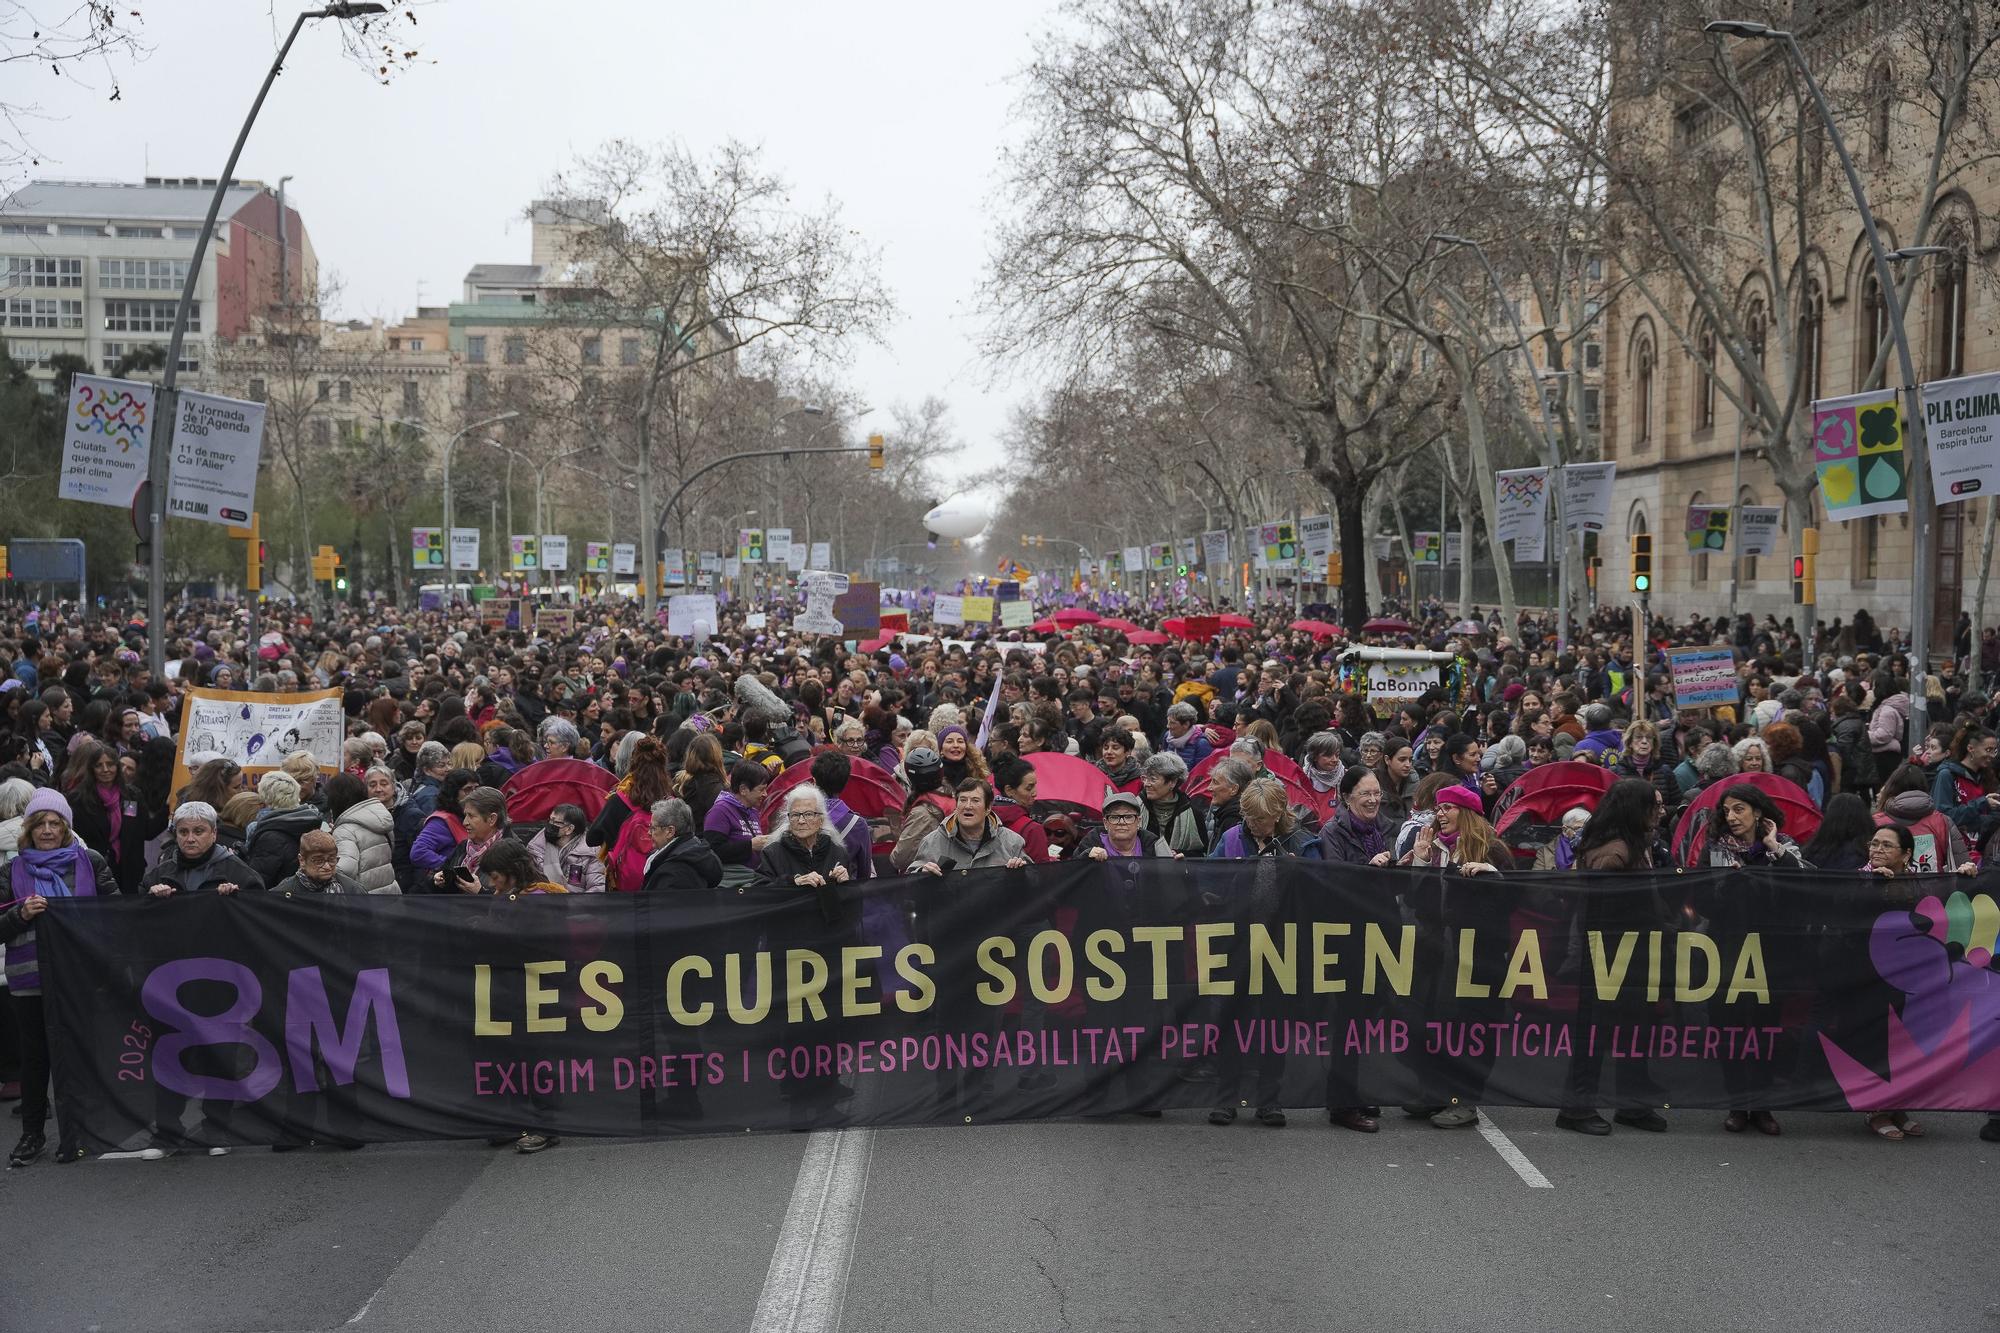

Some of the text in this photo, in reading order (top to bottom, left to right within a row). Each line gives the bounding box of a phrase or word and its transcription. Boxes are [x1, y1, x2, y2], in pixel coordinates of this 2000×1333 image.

[184, 401, 245, 422] IV Jornada
[1926, 392, 2000, 425] PLA CLIMA
[181, 423, 209, 437] 2030
[183, 412, 250, 433] de l'Agenda
[1940, 425, 1987, 439] Barcelona
[73, 440, 107, 453] Ciutats
[1936, 434, 1994, 451] respira futur
[71, 454, 90, 463] que
[105, 459, 136, 470] mouen
[177, 454, 192, 465] Ca
[180, 444, 236, 464] 11 de març
[70, 465, 113, 479] pel clima
[170, 498, 208, 515] PLA CLIMA
[474, 922, 1771, 1037] LES CURES SOSTENEN LA VIDA
[141, 957, 411, 1104] 8M
[118, 1020, 152, 1082] 2025
[474, 1012, 1784, 1096] EXIGIM DRETS I CORRESPONSABILITAT PER VIURE AMB JUSTÍCIA I LLIBERTAT
